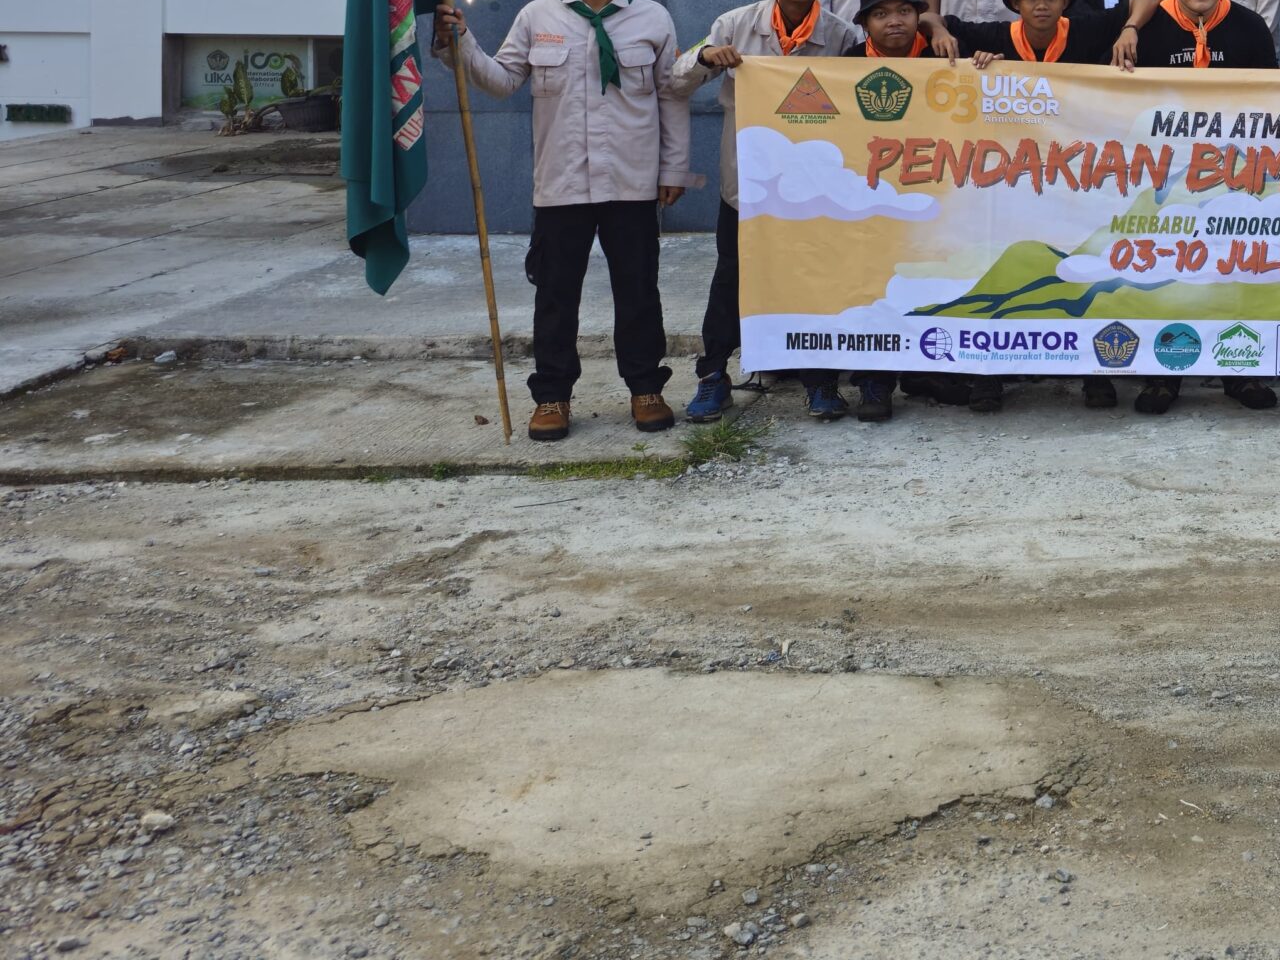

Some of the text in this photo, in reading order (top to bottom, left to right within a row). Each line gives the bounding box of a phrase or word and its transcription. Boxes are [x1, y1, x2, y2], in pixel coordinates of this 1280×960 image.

[925, 69, 978, 124] 63
[981, 75, 1054, 98] UIKA
[982, 97, 1060, 115] BOGOR
[984, 115, 1047, 125] Anniversary
[1151, 111, 1222, 138] MAPA
[866, 137, 1175, 197] PENDAKIAN
[1110, 214, 1199, 238] MERBABU,
[1109, 239, 1209, 273] 03-10
[786, 332, 833, 350] MEDIA
[837, 333, 901, 352] PARTNER
[959, 330, 1079, 352] EQUATOR
[958, 350, 1080, 362] Menuju Masyarakat Berdaya
